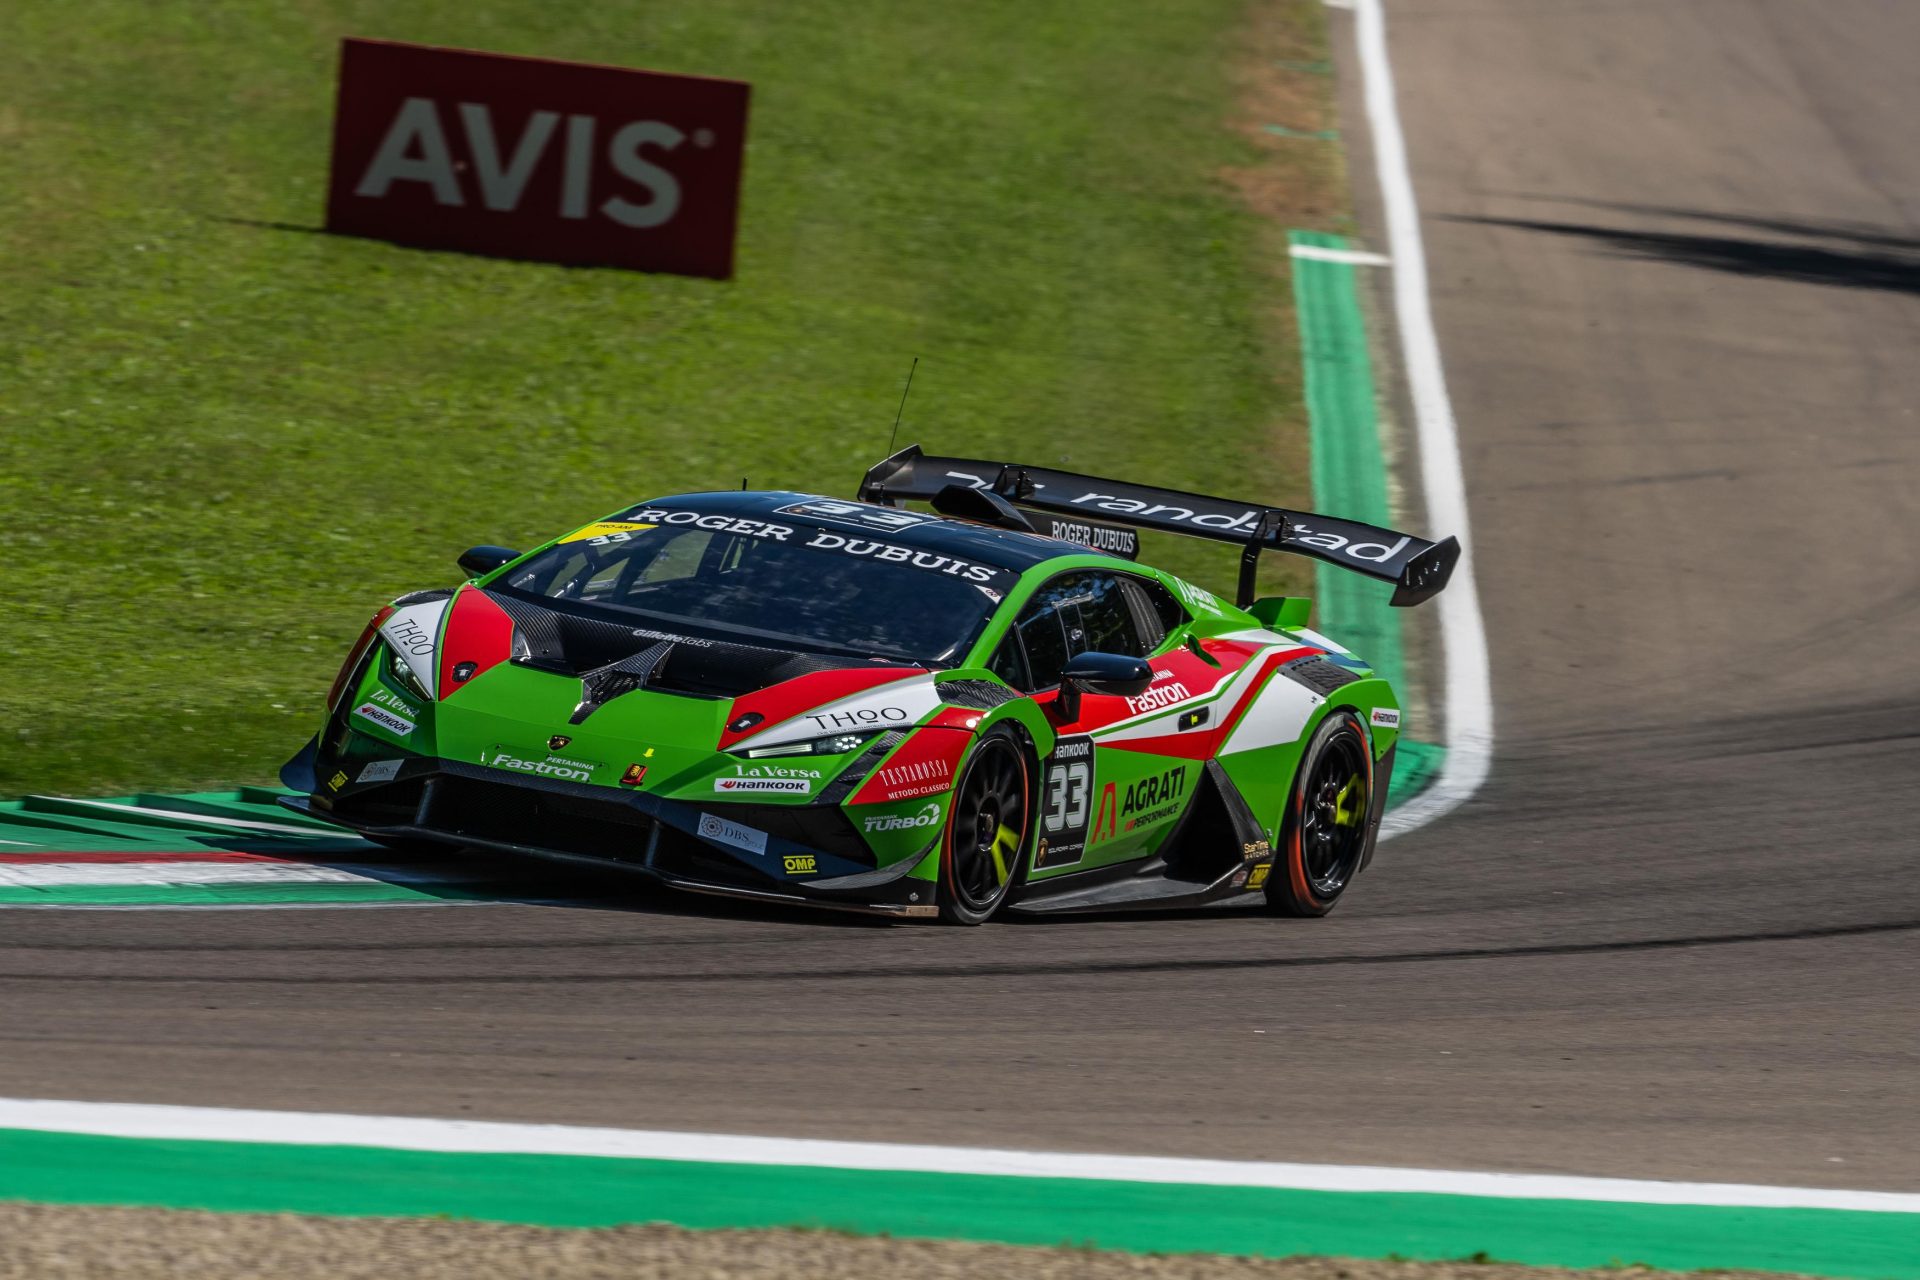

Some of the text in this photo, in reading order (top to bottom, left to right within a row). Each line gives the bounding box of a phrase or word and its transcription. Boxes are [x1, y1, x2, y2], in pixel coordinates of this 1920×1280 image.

[354, 97, 688, 229] AVIS
[585, 531, 632, 546] 33
[627, 509, 794, 541] ROGER
[806, 533, 998, 582] DUBUIS
[1052, 521, 1135, 553] ROGER DUBUIS
[370, 689, 389, 702] La
[1125, 682, 1191, 715] Fastron
[492, 754, 591, 782] Fastron
[546, 756, 595, 771] PERTAMINA
[736, 765, 822, 779] La Versa
[879, 759, 949, 787] TESTAROSSA
[887, 782, 950, 800] METODO CLASSICO
[1044, 762, 1089, 832] 33
[1120, 765, 1186, 817] AGRATI
[864, 815, 930, 833] TURBO
[1133, 802, 1180, 828] PERFORMANCE
[784, 858, 816, 870] OMP
